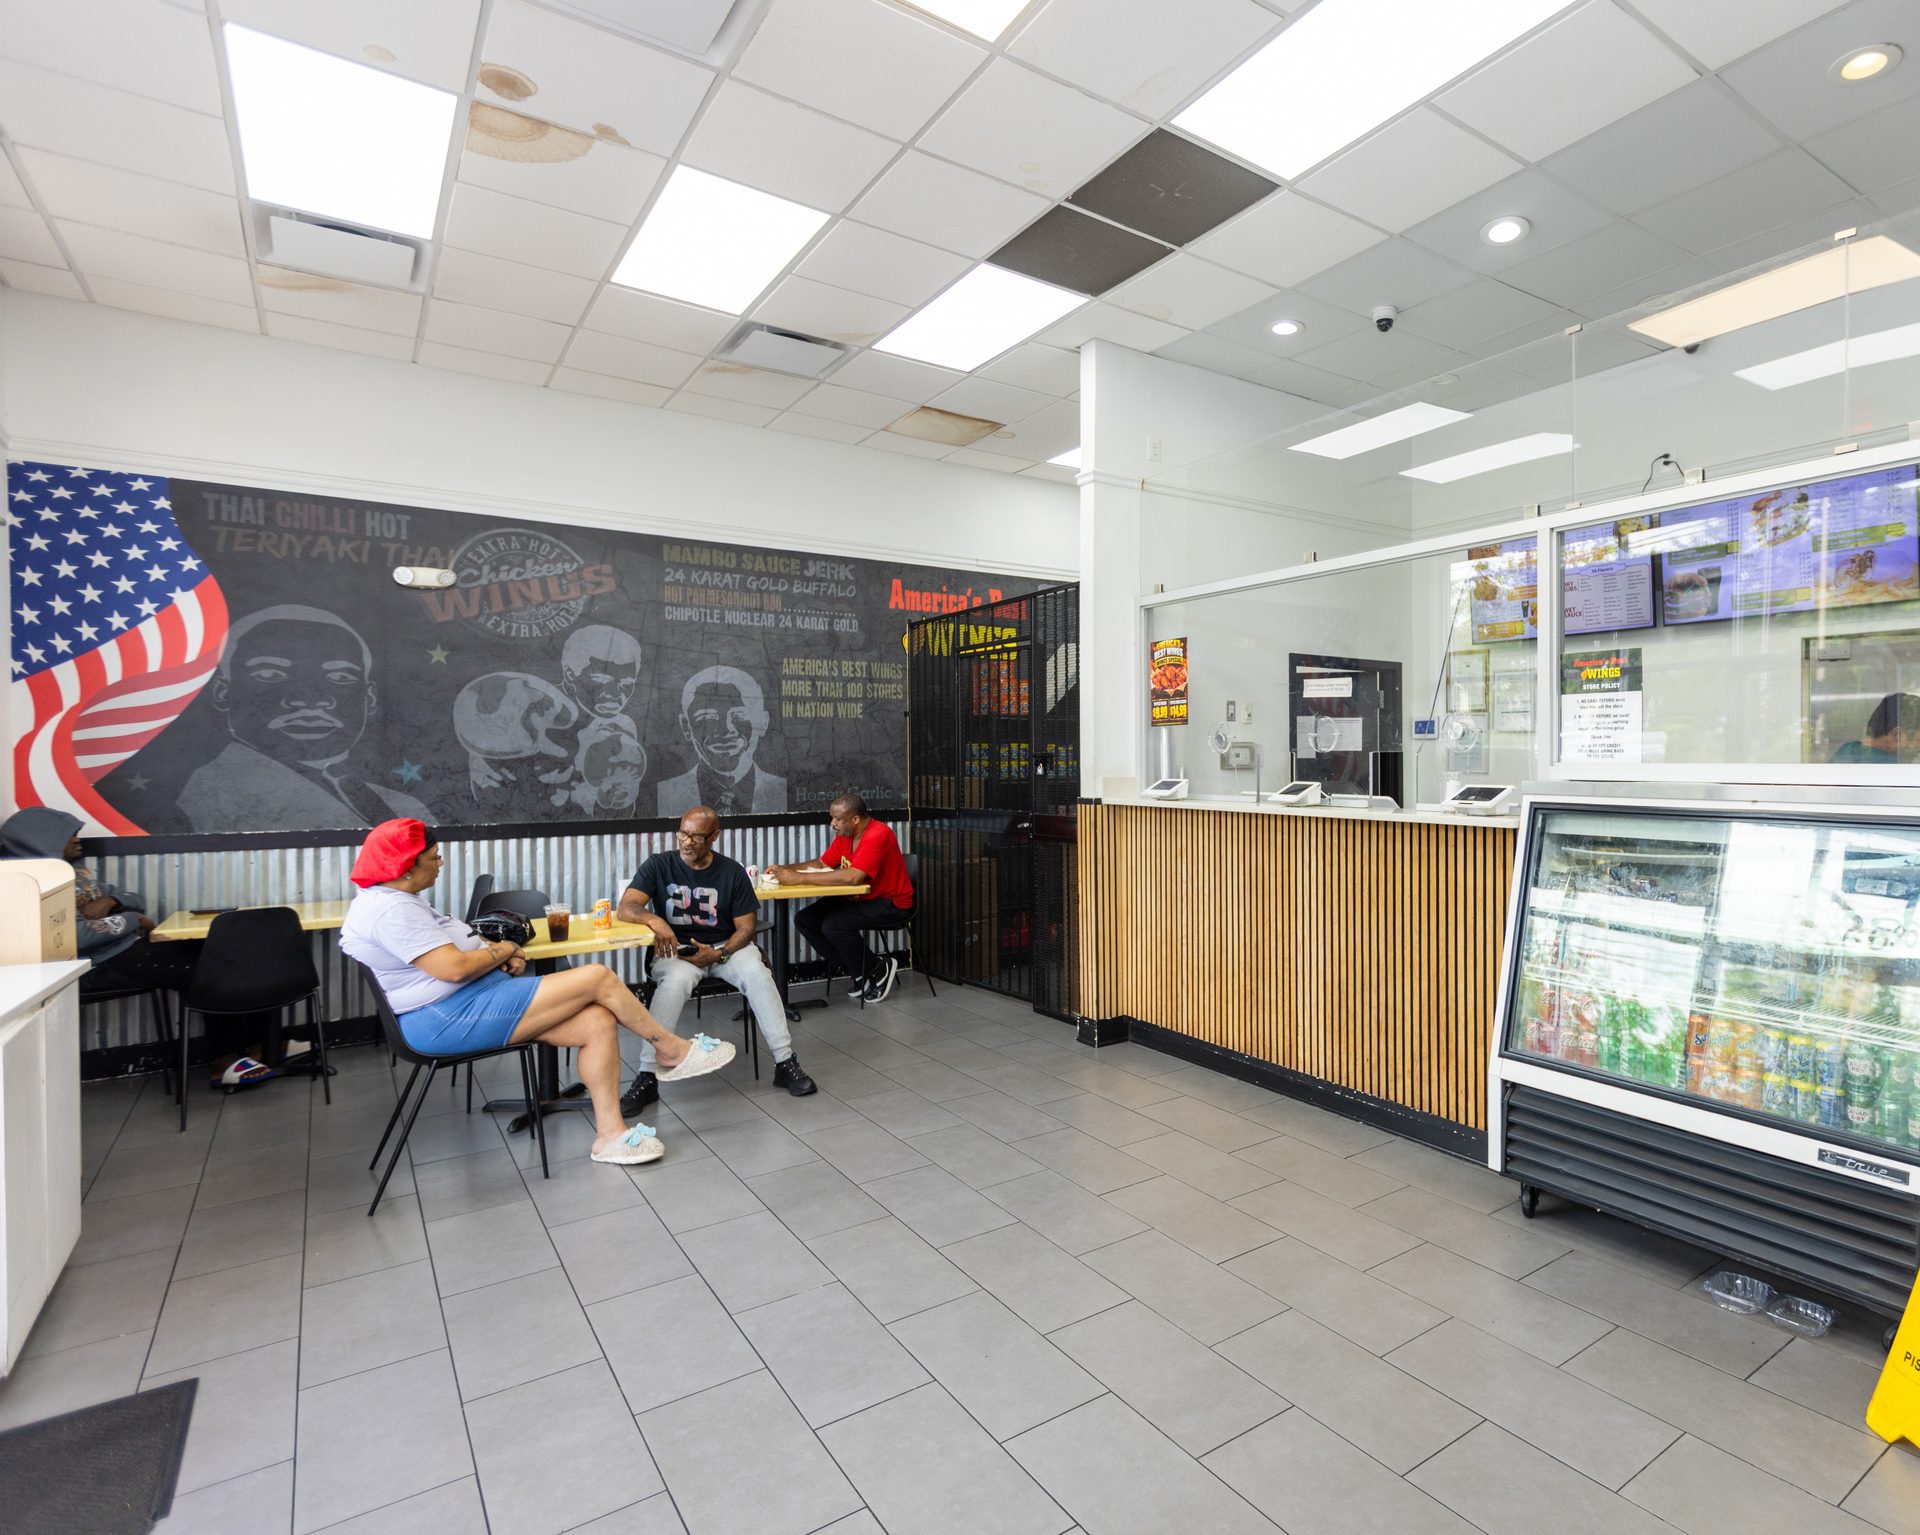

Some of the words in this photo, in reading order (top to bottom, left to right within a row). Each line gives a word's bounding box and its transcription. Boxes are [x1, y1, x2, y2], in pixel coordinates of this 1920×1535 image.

[202, 492, 265, 525] THAI
[275, 500, 355, 535] CHILLI
[365, 510, 412, 540] HOT
[209, 525, 371, 564] TERIYAKI
[467, 536, 520, 564] EXTRA
[529, 538, 561, 560] HOT
[455, 558, 578, 588] Chicken
[663, 543, 736, 569] MAMBO
[741, 552, 801, 576] SAUCE
[803, 560, 856, 580] JERK
[664, 568, 686, 583] 24
[691, 570, 743, 590] KARAT
[747, 576, 788, 592] GOLD
[793, 580, 856, 597] BUFFALO
[664, 585, 683, 603] HOT
[485, 615, 542, 638] EXTRA
[665, 606, 720, 624] CHIPOTLE
[724, 610, 775, 627] NUCLEAR
[778, 614, 793, 628] 24
[796, 616, 830, 631] KARAT
[834, 618, 859, 633] GOLD
[783, 658, 838, 677] AMERICA'S
[842, 660, 868, 678] BEST
[871, 662, 903, 679] WINGS
[1588, 667, 1621, 679] WINGS
[782, 680, 812, 697] MORE
[815, 681, 843, 698] THAN
[847, 682, 863, 698] 100
[867, 683, 903, 699] STORES
[782, 701, 793, 718] IN
[797, 701, 833, 718] NATION
[837, 702, 863, 718] WIDE
[666, 883, 719, 927] 23
[1845, 1158, 1888, 1176] true
